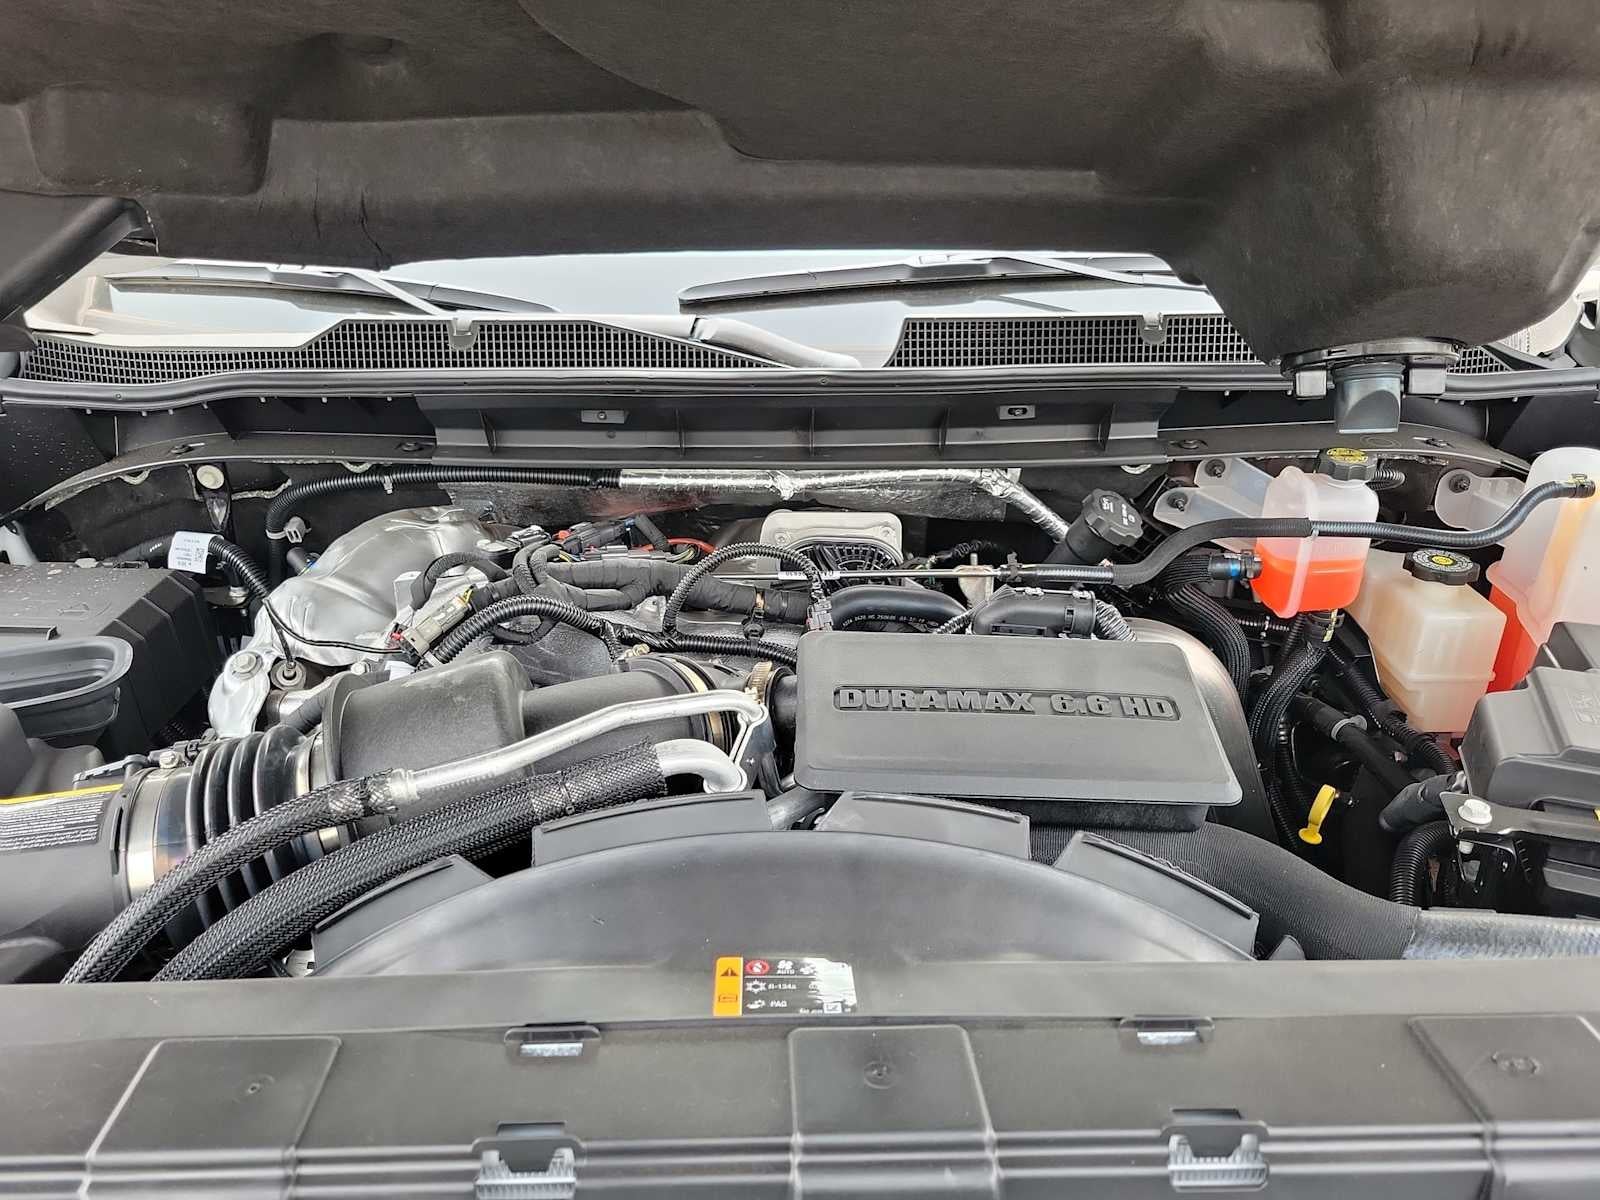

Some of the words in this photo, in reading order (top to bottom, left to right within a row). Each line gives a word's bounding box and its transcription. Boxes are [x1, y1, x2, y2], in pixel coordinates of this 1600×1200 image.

[839, 688, 1036, 714] DURAMAX
[1049, 692, 1113, 716] 6.6
[1119, 695, 1175, 718] HD
